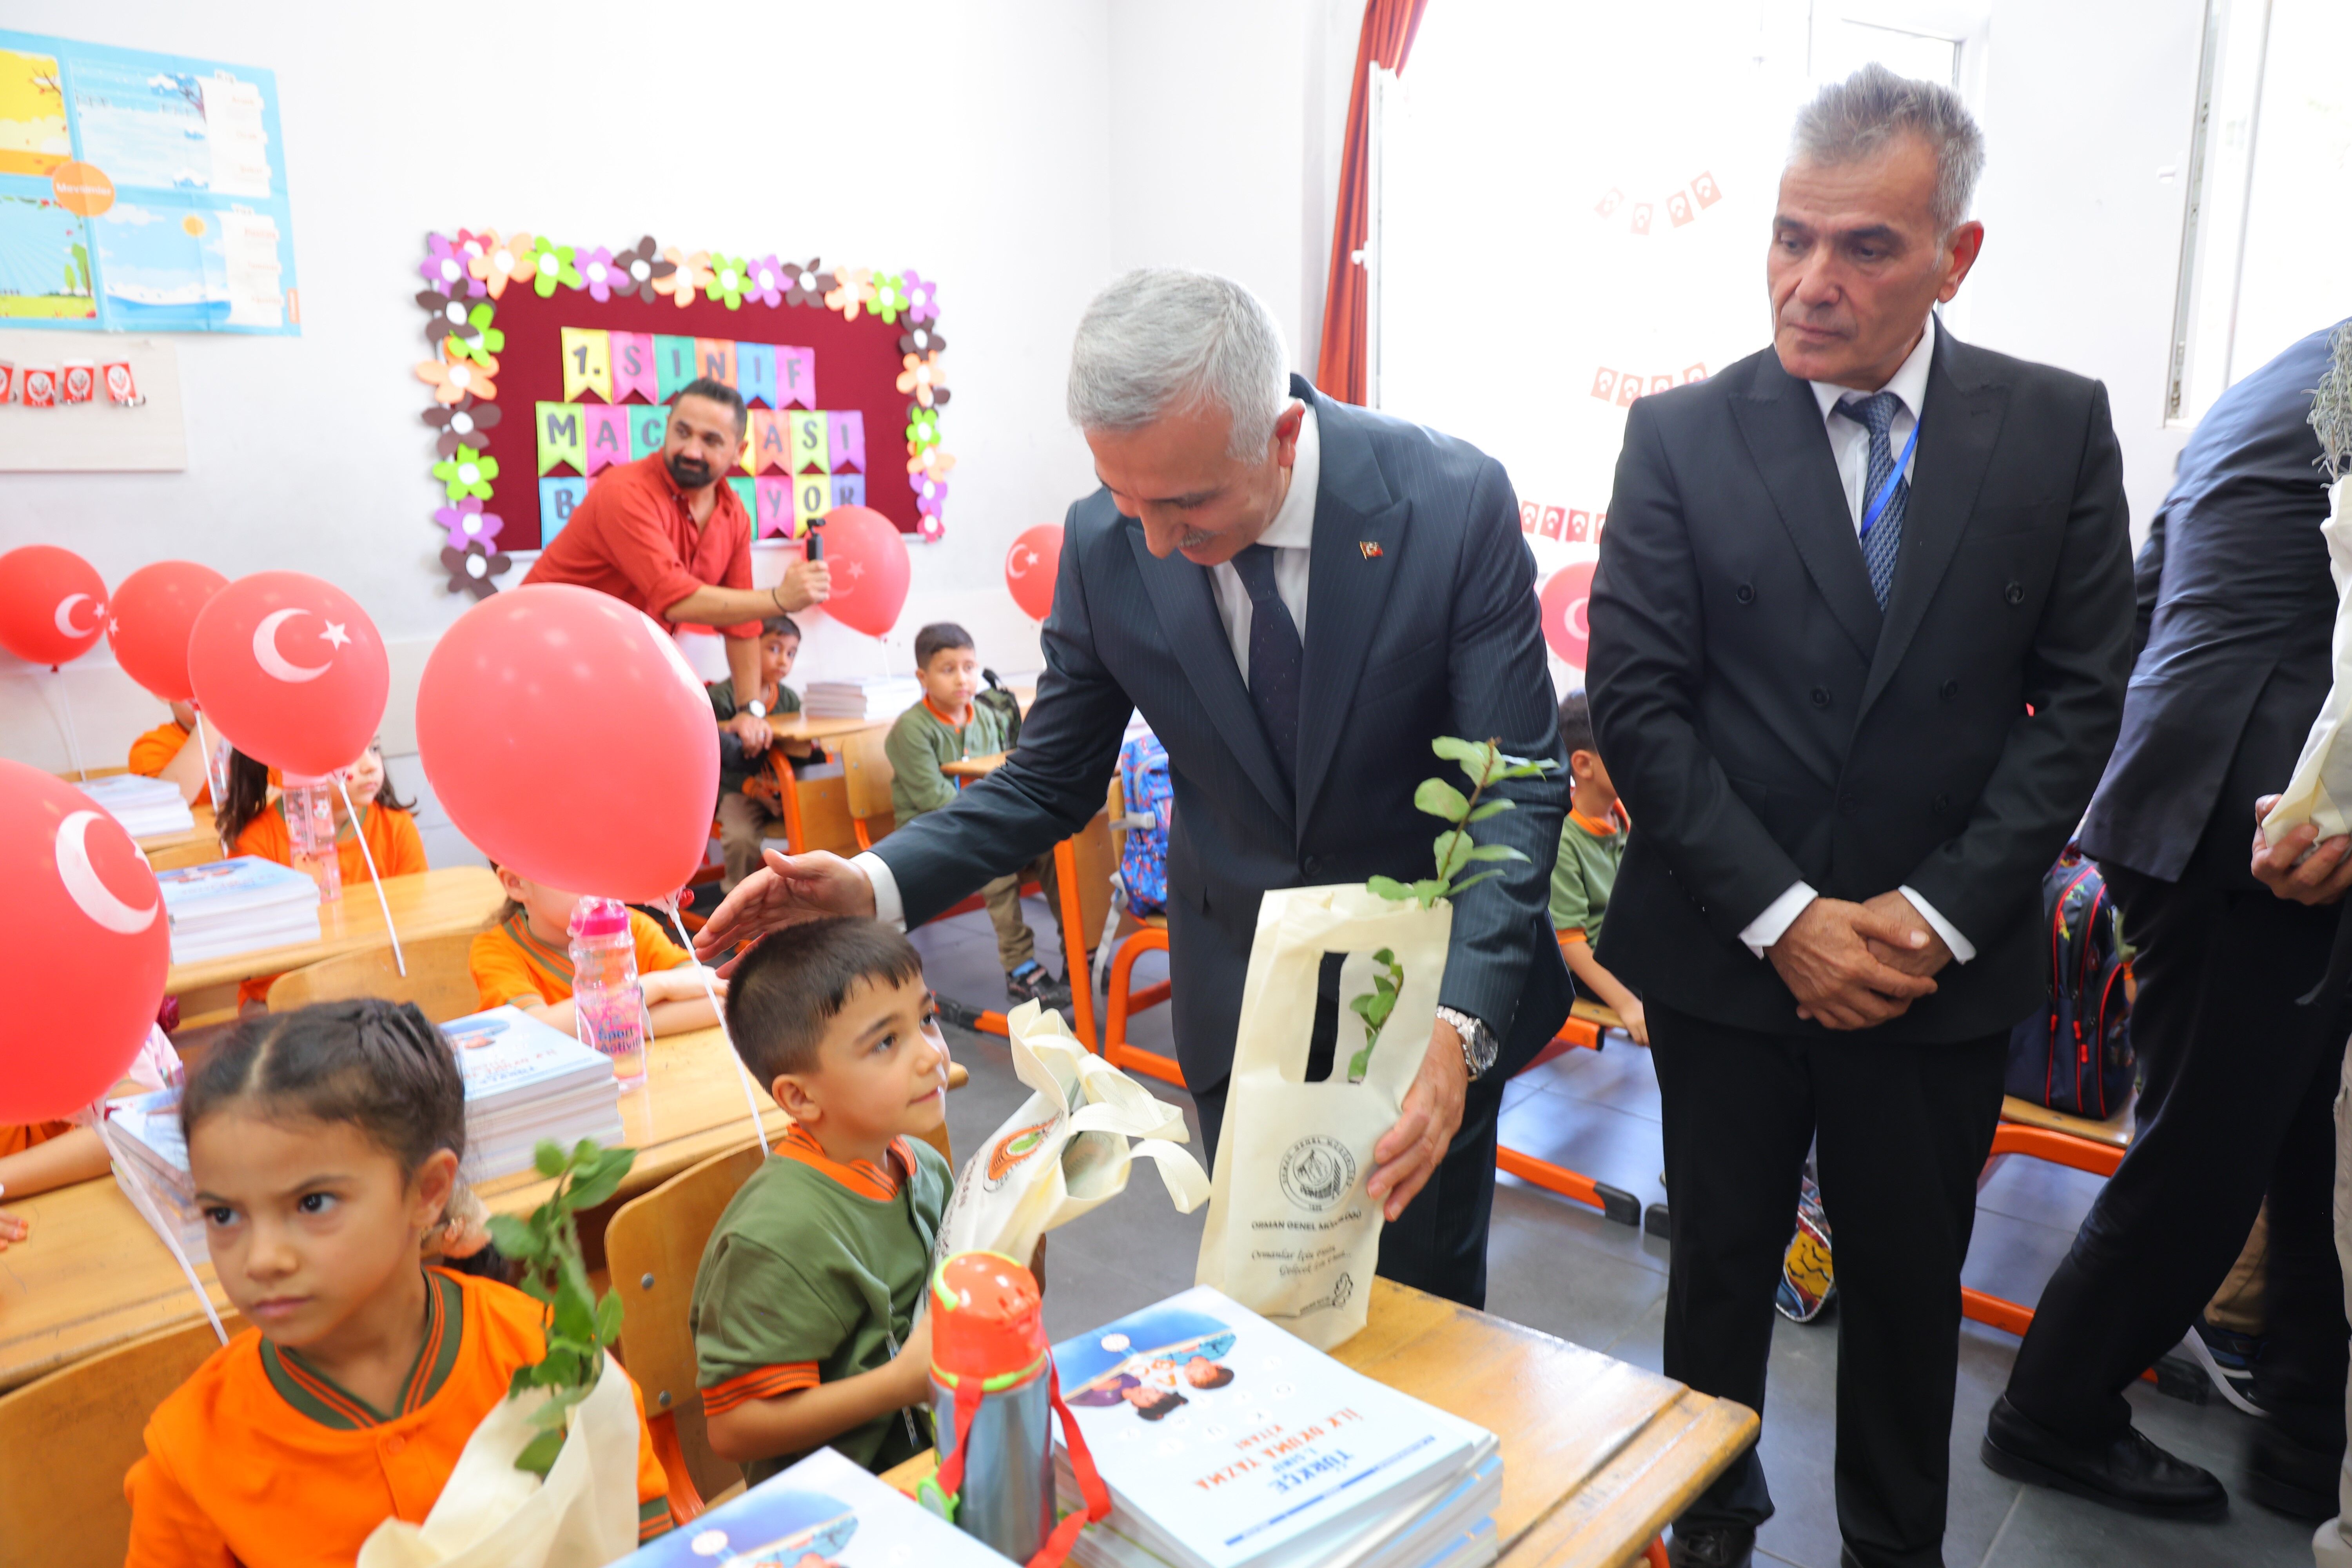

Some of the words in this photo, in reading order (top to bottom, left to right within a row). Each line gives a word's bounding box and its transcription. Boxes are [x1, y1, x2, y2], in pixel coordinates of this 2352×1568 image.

[573, 345, 600, 374] 1.
[624, 345, 801, 388] SINIF
[548, 414, 849, 452] MACASI
[1252, 1220, 1285, 1230] ORMAN
[1287, 1221, 1316, 1231] GENEL
[1326, 1407, 1363, 1428] İLK
[1261, 1426, 1325, 1458] OKUMA
[1194, 1457, 1261, 1490] YAZMA
[1267, 1449, 1354, 1495] TÜRKÇE
